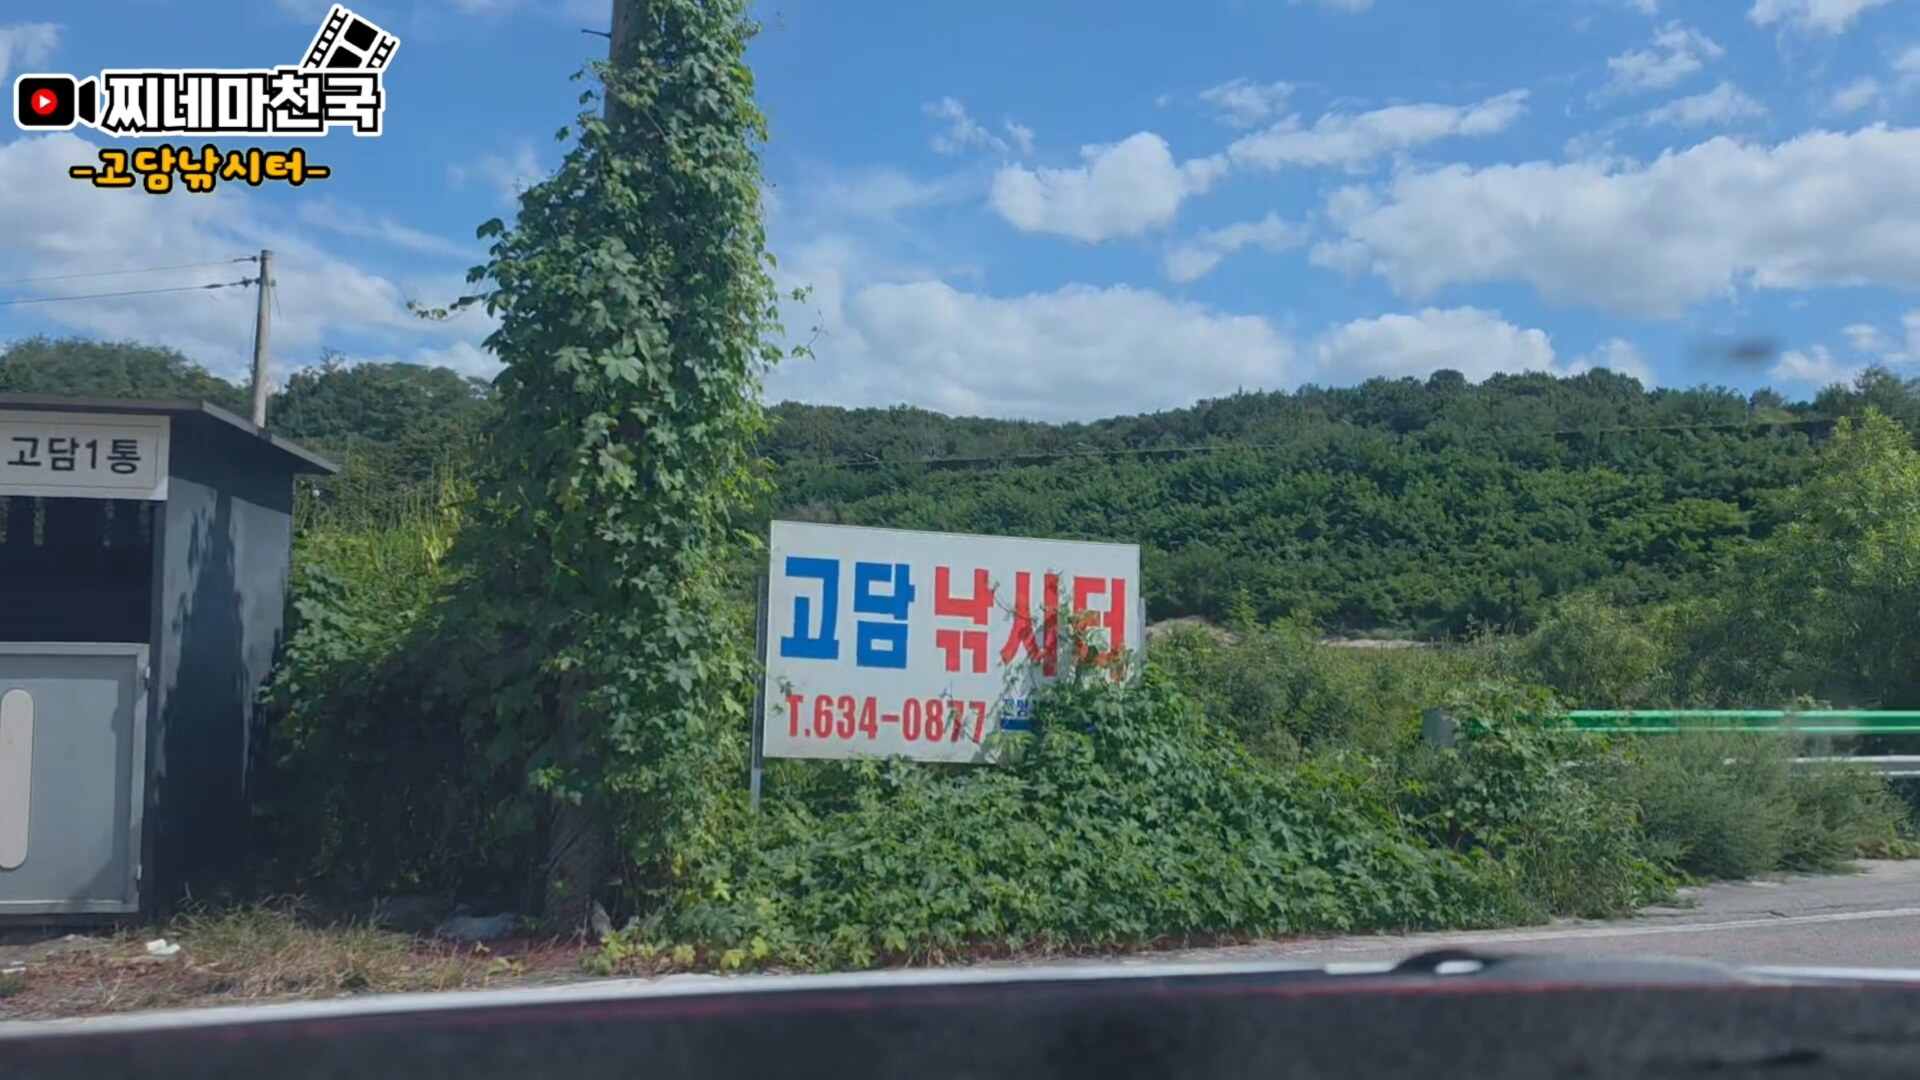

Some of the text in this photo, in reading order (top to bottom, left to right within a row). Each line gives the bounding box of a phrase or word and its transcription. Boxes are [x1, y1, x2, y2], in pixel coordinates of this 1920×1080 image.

[7, 437, 141, 474] 고담1통
[780, 556, 915, 669] 고담
[786, 694, 986, 743] T.634-0877
